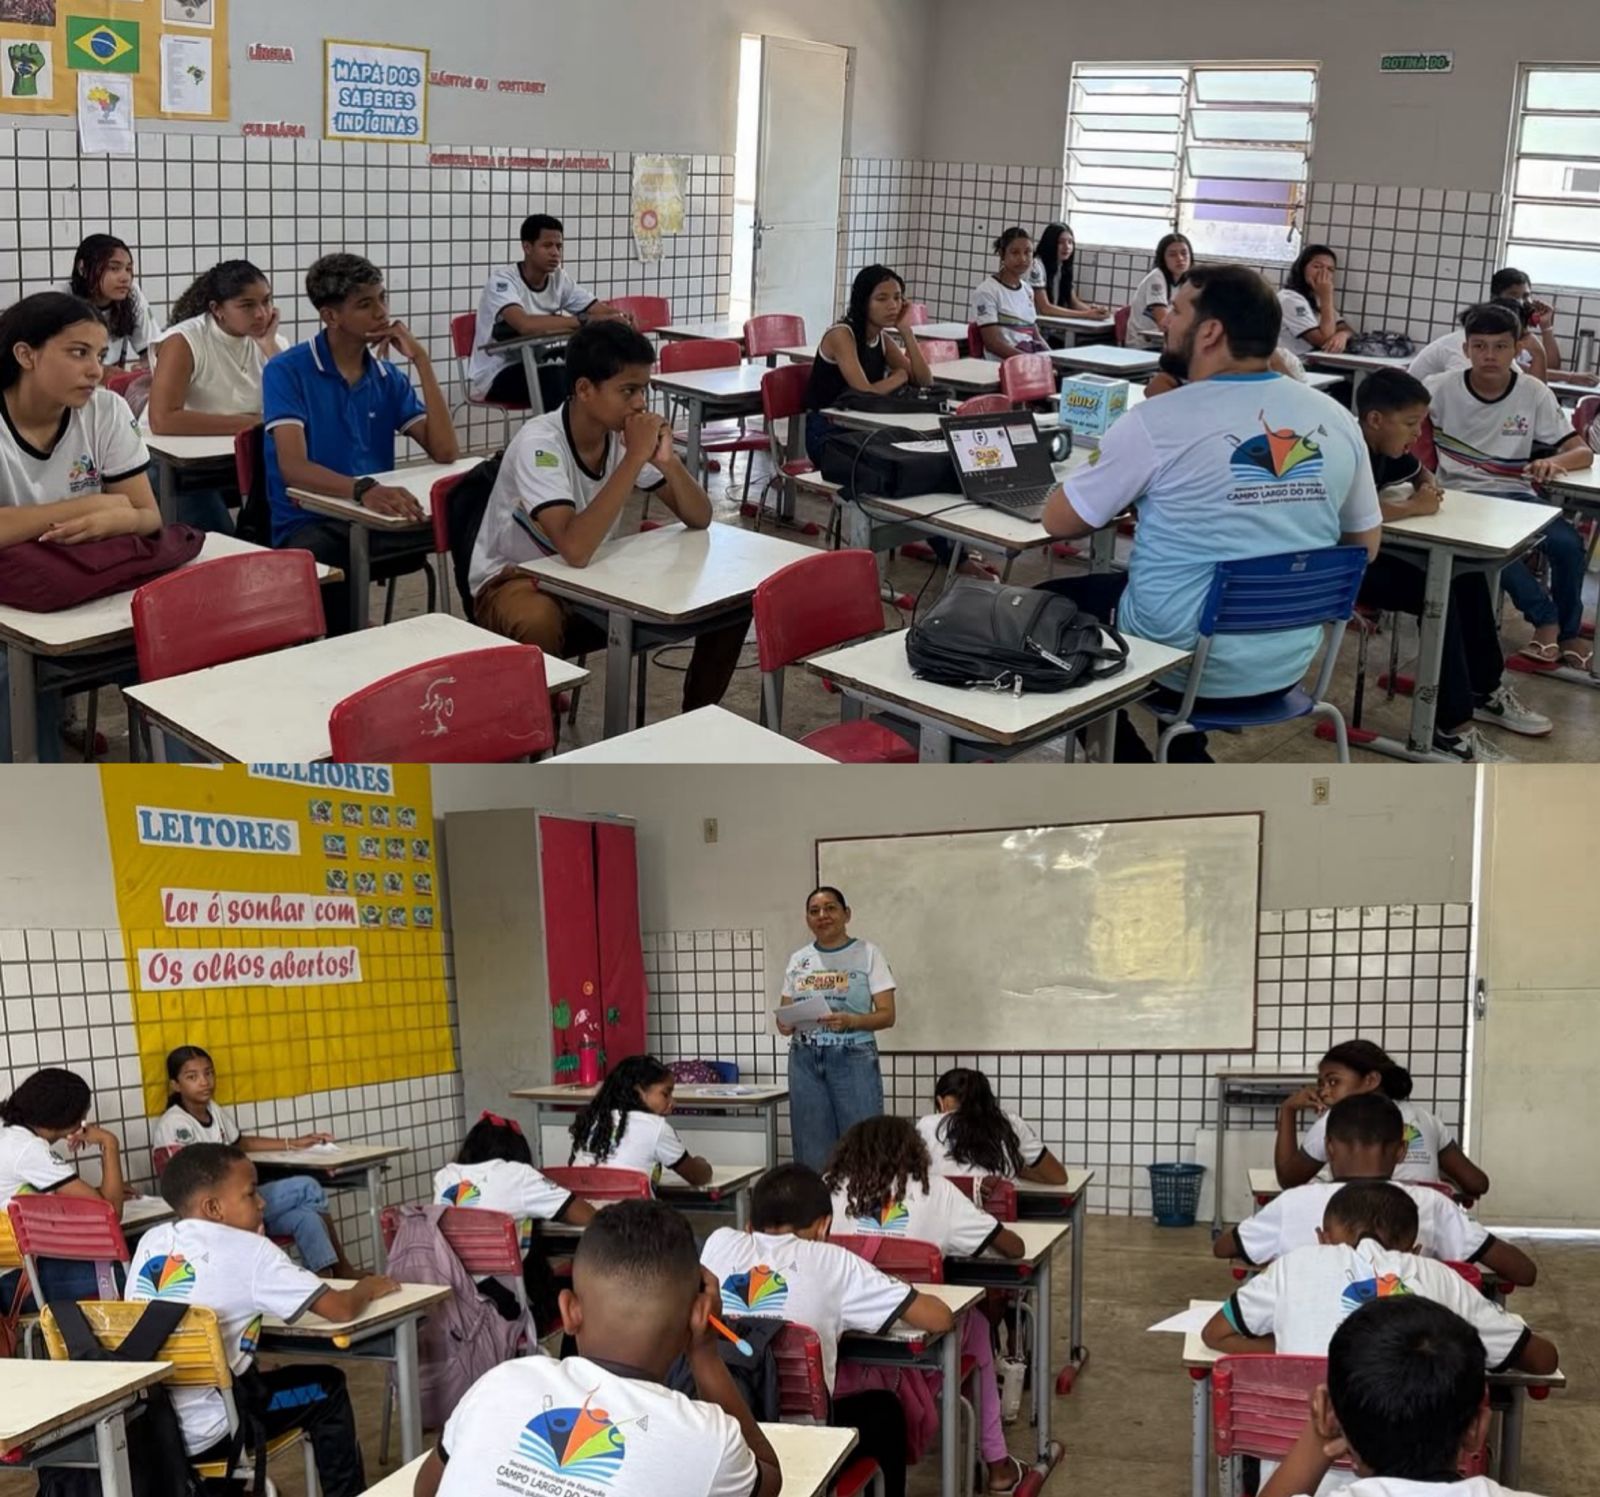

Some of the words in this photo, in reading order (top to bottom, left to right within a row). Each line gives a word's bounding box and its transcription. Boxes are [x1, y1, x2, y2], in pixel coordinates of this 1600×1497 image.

[332, 58, 384, 83] MAPA
[386, 65, 420, 86] DOS
[338, 85, 417, 110] SABERES
[333, 108, 419, 135] INDÍGINAS
[1227, 491, 1259, 501] CAMPO
[1261, 488, 1288, 499] LARGO
[1290, 487, 1304, 496] DO
[139, 810, 292, 851] LEITORES
[164, 892, 198, 923] Ler
[207, 892, 220, 922] é
[227, 895, 305, 924] sonhar
[314, 902, 356, 924] com
[149, 952, 183, 985] Os
[192, 951, 265, 983] olhos
[269, 949, 356, 980] abertos!
[496, 1465, 530, 1484] CAMPO
[530, 1478, 563, 1497] LARGO
[508, 1460, 539, 1476] Secretaria
